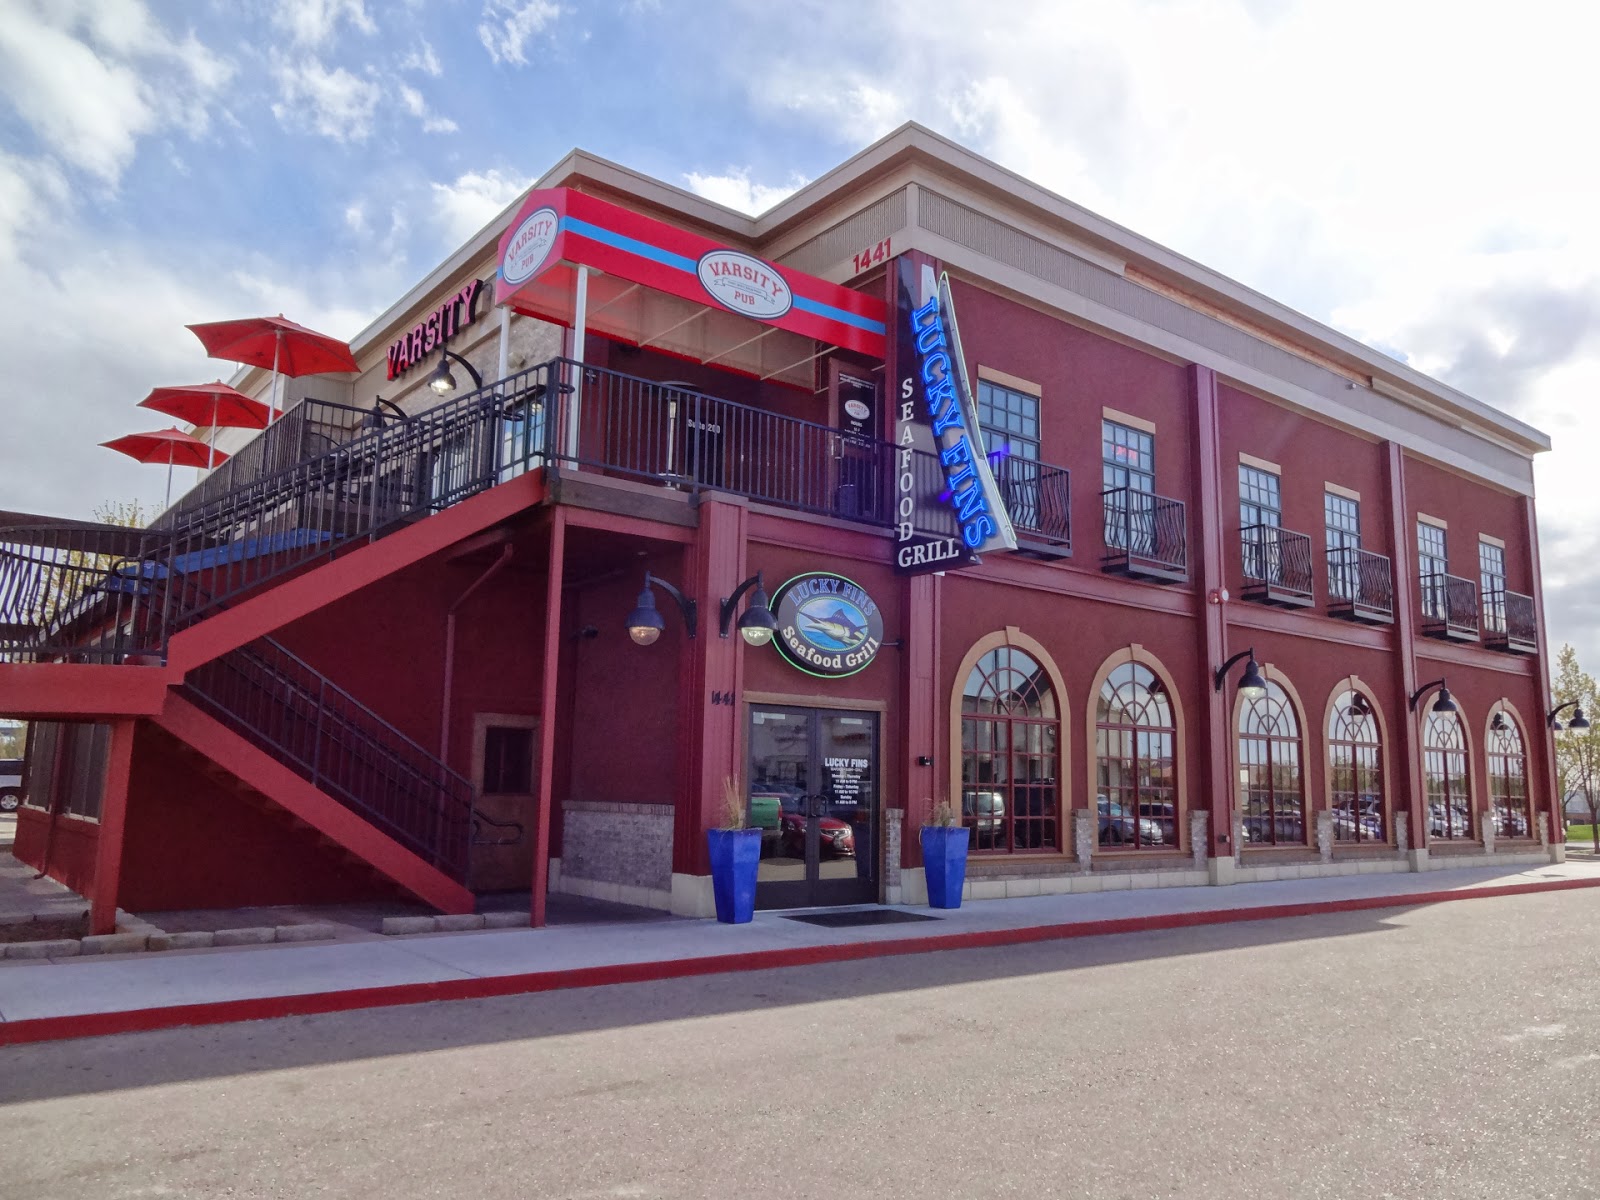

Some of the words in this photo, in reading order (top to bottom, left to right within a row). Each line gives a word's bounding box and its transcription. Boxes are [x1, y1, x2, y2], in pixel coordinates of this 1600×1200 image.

[508, 220, 552, 261] VARSITY
[853, 237, 892, 274] 1441
[521, 253, 534, 270] PUB
[708, 262, 783, 297] VARSITY
[734, 291, 755, 305] PUB
[387, 279, 482, 381] VARSITY
[688, 419, 705, 430] Sute
[911, 296, 964, 437] LUCKY
[943, 435, 996, 548] FINS
[899, 378, 914, 542] SEAFOOD
[898, 537, 960, 568] GRILL
[788, 578, 840, 606] LUCKY
[843, 582, 876, 616] FINS
[783, 625, 842, 668] Seafood
[846, 637, 879, 667] Grill
[824, 758, 849, 767] LUCKY
[851, 759, 868, 768] FINS
